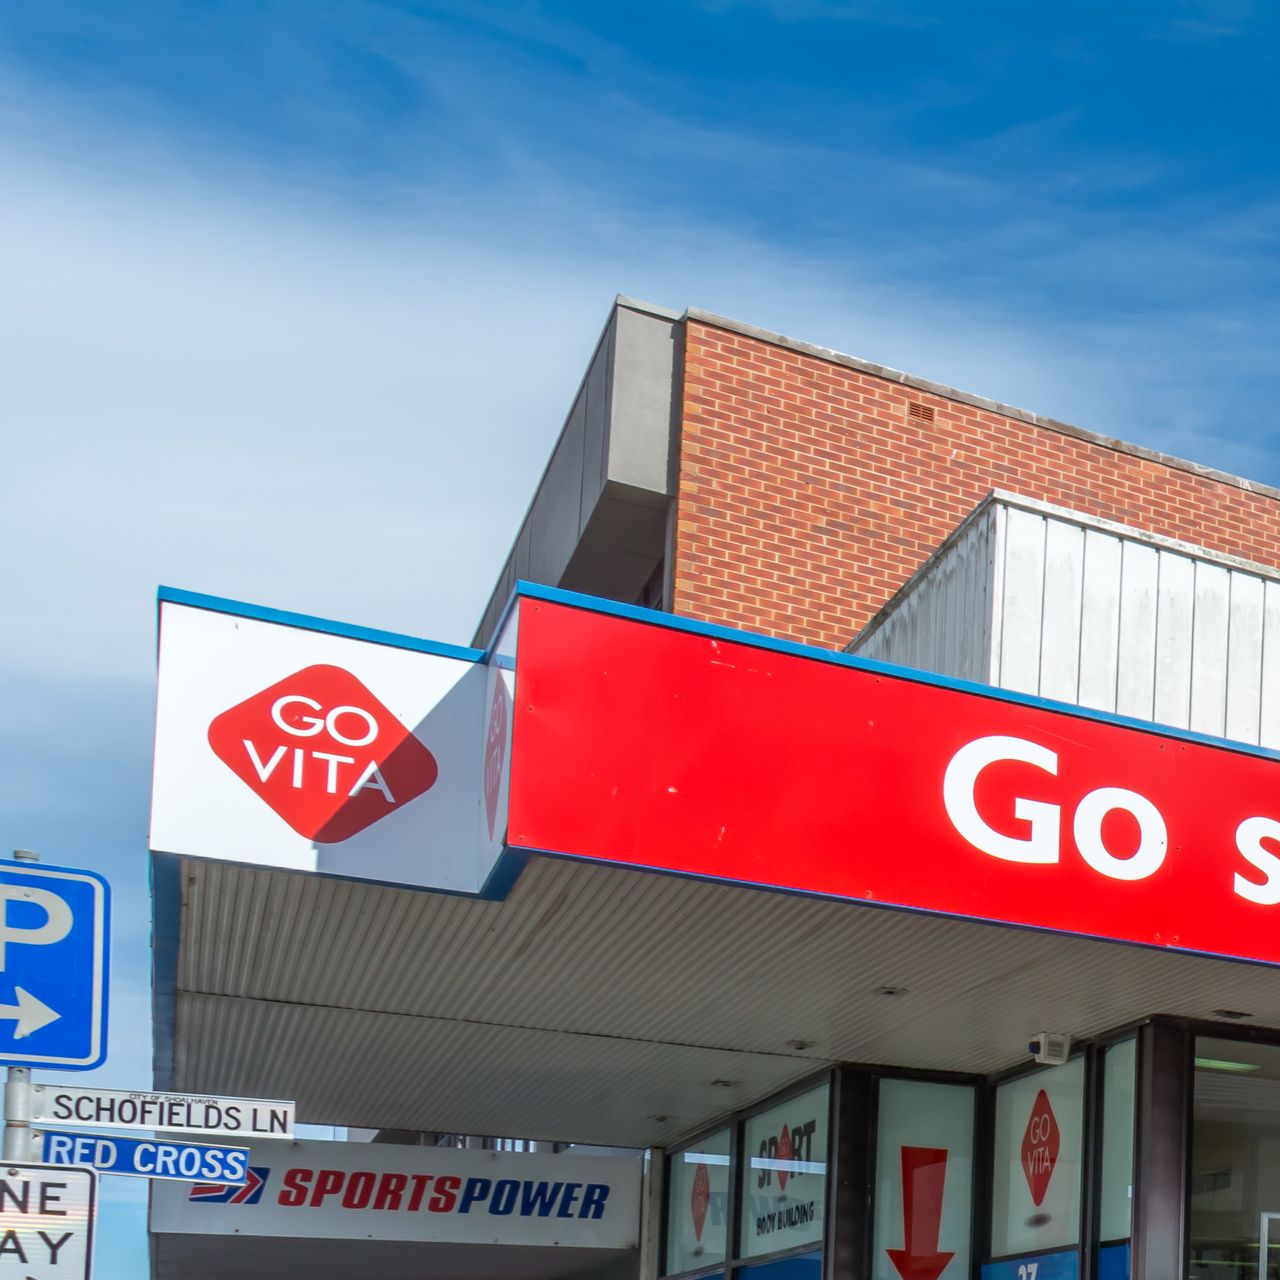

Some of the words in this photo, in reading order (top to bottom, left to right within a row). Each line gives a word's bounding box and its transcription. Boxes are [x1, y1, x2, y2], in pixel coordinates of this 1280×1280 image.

[271, 694, 379, 747] GO
[242, 738, 397, 804] VITA
[942, 734, 1169, 882] Go
[53, 1094, 242, 1131] SCHOFIELDS
[251, 1107, 288, 1134] LN
[1030, 1113, 1051, 1144] GO
[49, 1135, 118, 1169] RED
[133, 1143, 248, 1181] CROSS
[1027, 1147, 1051, 1176] VITA
[277, 1167, 611, 1220] SPORTSPOWER
[756, 1212, 775, 1237] BODY
[777, 1201, 815, 1232] BUILDING
